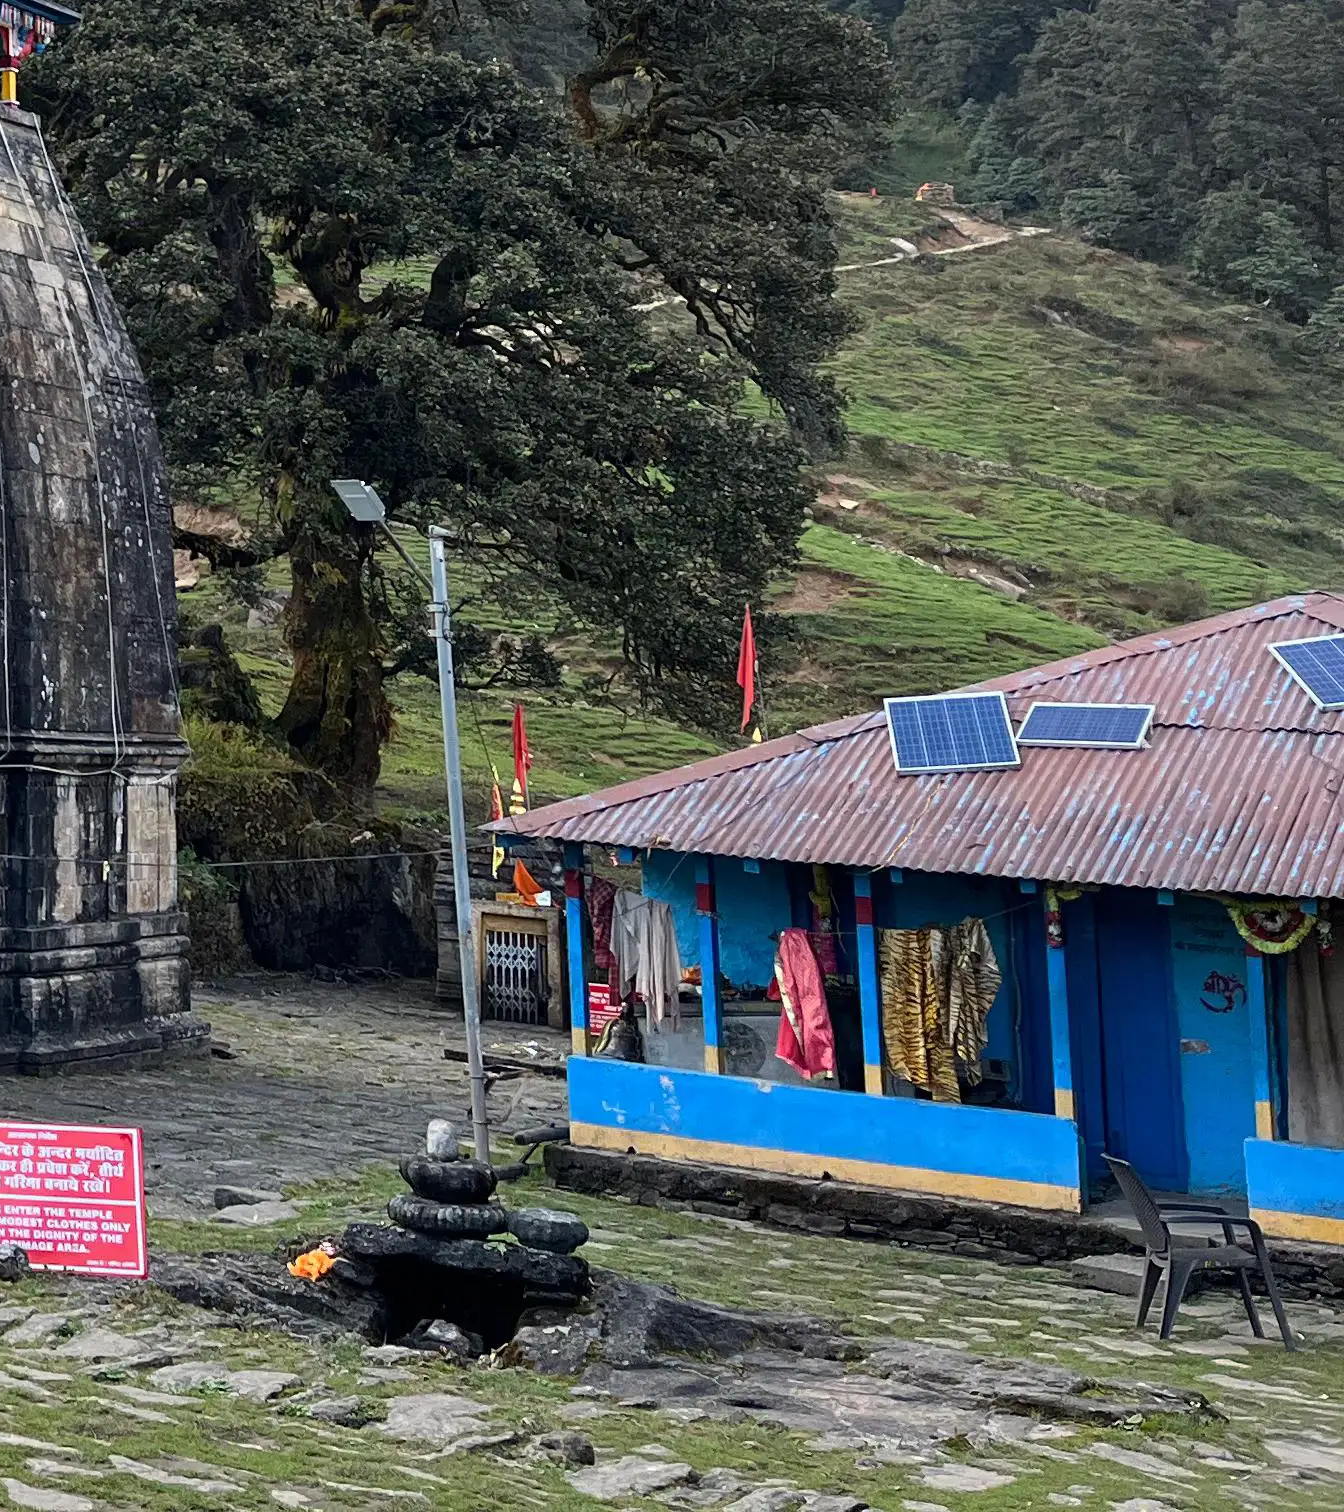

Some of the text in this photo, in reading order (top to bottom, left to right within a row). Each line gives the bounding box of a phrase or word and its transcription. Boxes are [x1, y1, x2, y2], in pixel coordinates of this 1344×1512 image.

[4, 1204, 41, 1216] ENTER
[43, 1206, 65, 1217] THE
[68, 1208, 112, 1220] TEMPLE
[46, 1218, 98, 1231] CLOTHES
[101, 1221, 131, 1233] ONLY
[8, 1227, 31, 1238] THE
[33, 1229, 80, 1241] DIGNITY
[82, 1231, 98, 1242] OF
[101, 1233, 123, 1244] THE
